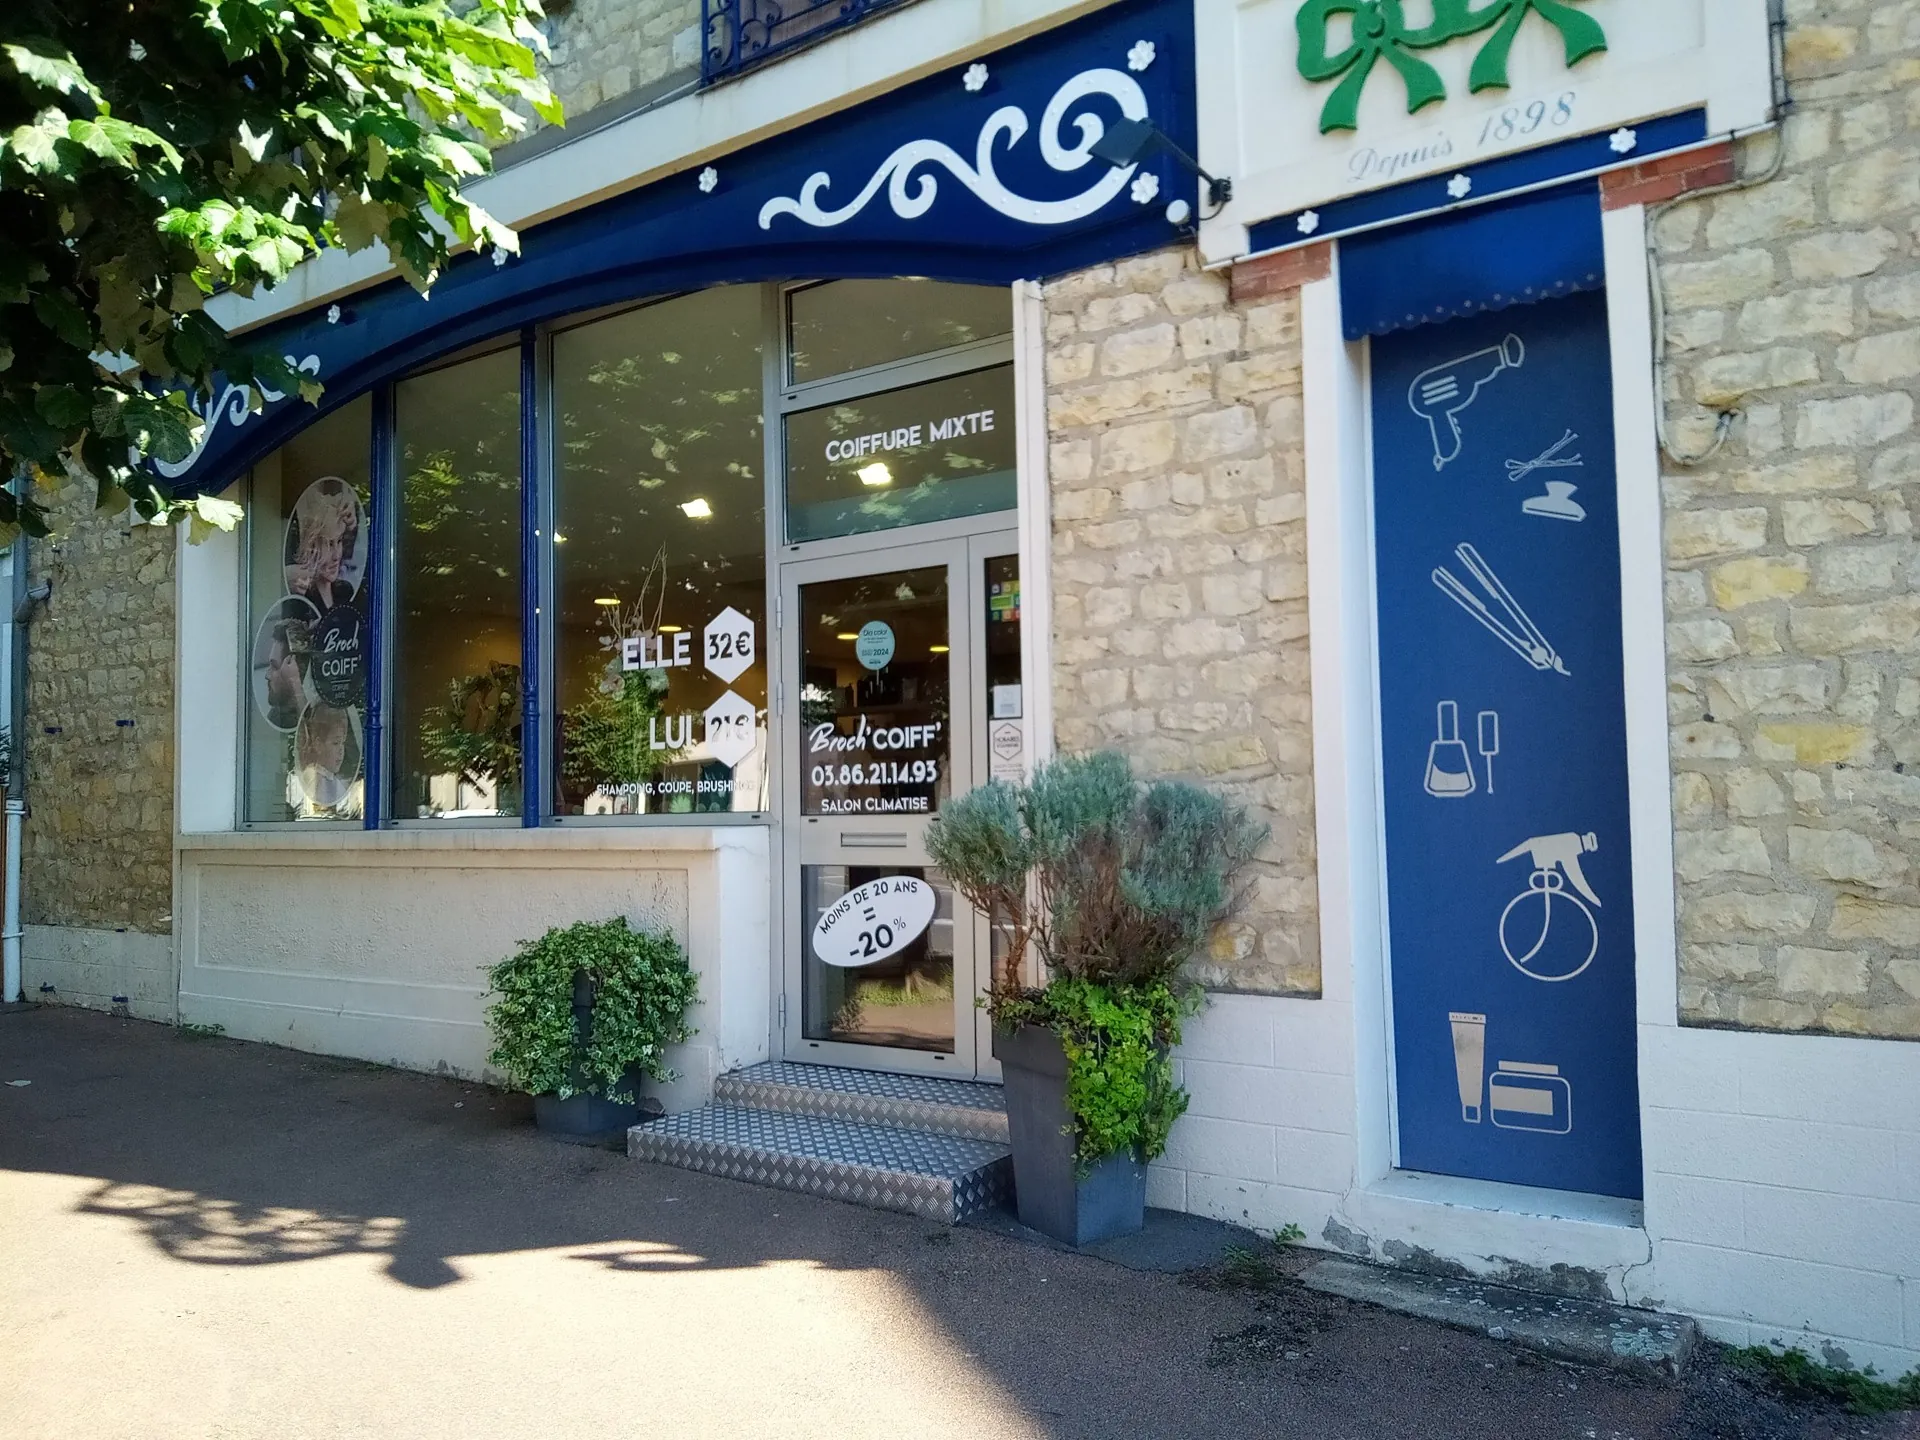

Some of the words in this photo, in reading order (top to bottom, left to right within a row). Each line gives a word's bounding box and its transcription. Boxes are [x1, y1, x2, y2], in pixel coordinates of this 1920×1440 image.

[1347, 131, 1453, 183] Depuis
[1477, 91, 1576, 148] 1898
[825, 425, 922, 461] COIFFURE
[929, 410, 995, 442] MIXTE
[324, 620, 359, 653] Broch
[623, 632, 691, 671] ELLE
[709, 631, 751, 660] 32€
[873, 648, 889, 656] 2024
[649, 715, 692, 750] LUI
[658, 780, 695, 795] COUPE,
[811, 760, 938, 786] 03.86.21.14.93
[821, 798, 861, 812] SALON
[865, 796, 928, 811] CLIMATISE
[819, 900, 851, 934] MOINS
[853, 888, 869, 904] DE
[873, 881, 889, 896] 20
[893, 881, 918, 893] ANS
